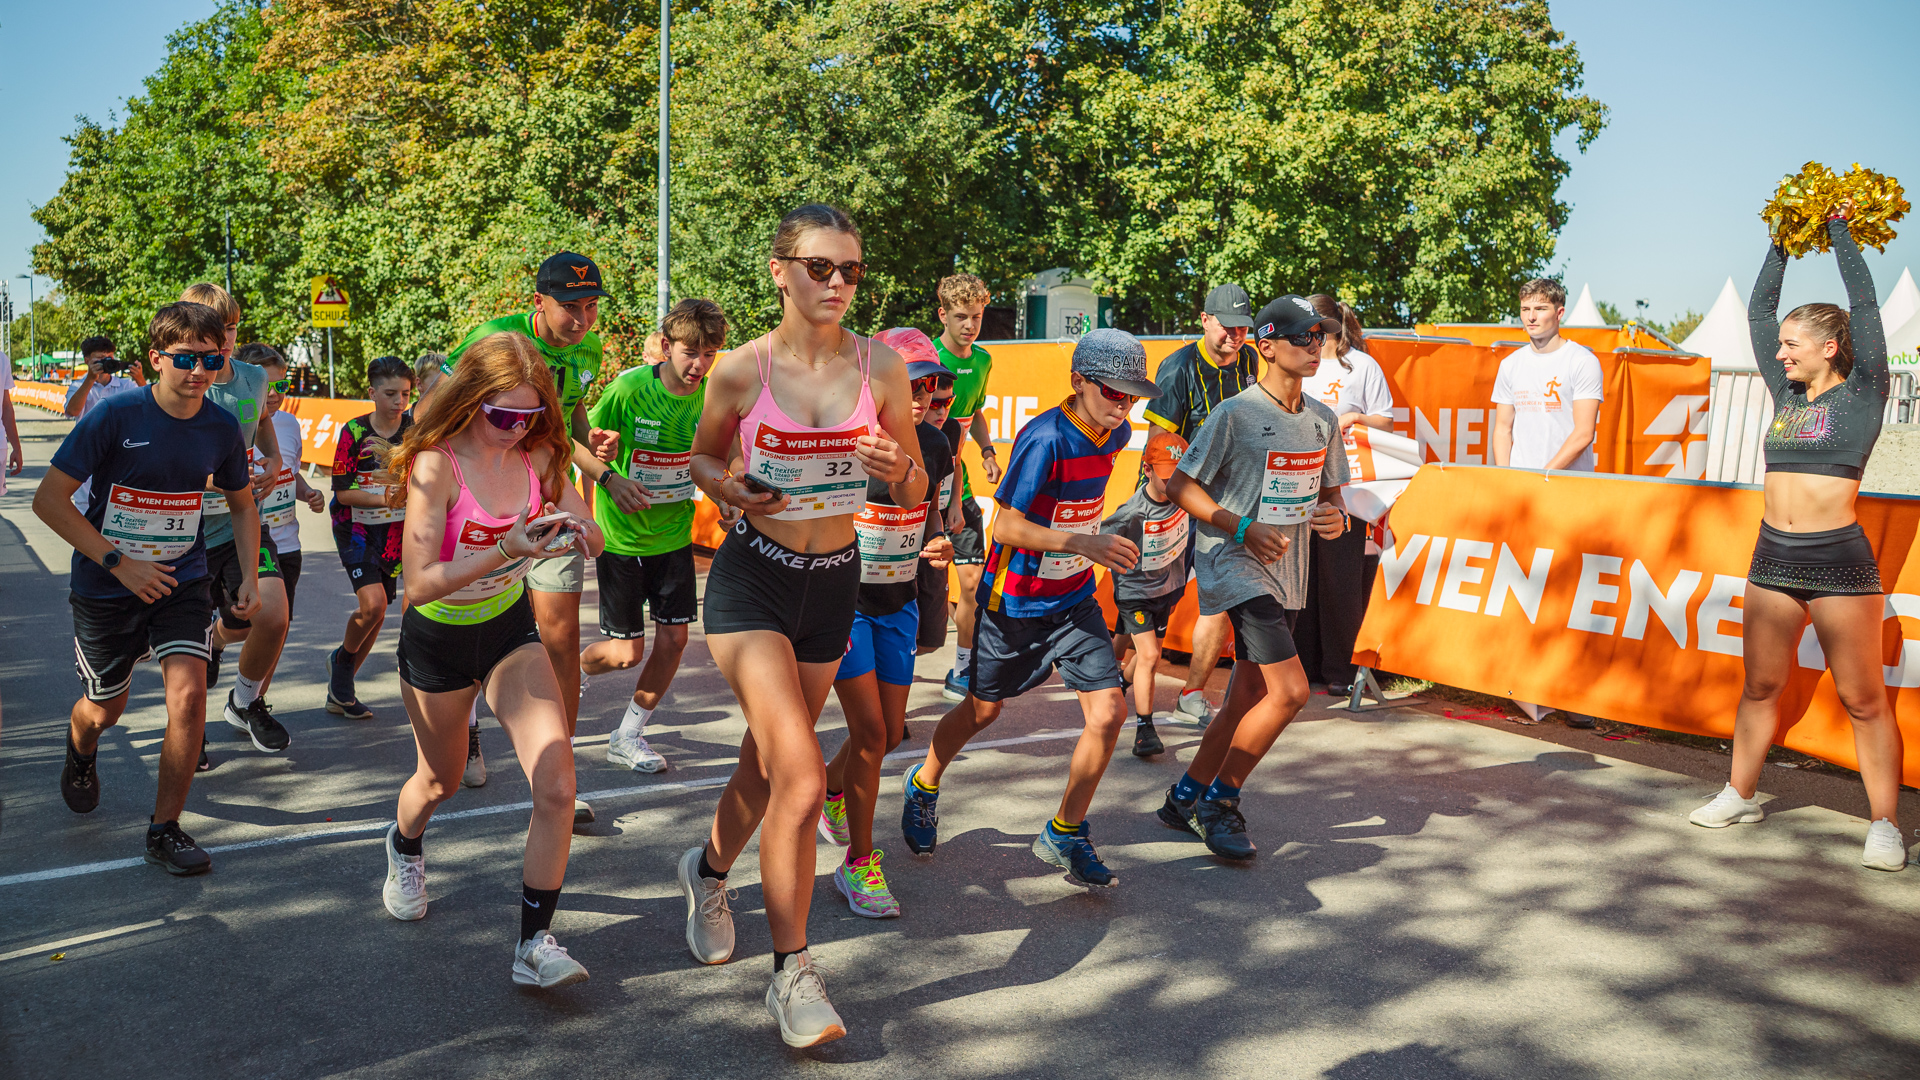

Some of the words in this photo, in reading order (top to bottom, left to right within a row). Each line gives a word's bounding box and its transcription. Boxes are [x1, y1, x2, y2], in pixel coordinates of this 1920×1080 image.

[313, 310, 348, 321] SCHULE
[1065, 312, 1083, 326] TOI
[1887, 351, 1920, 365] ntu
[635, 416, 661, 427] Kempa
[785, 439, 817, 449] WIEN
[819, 438, 857, 447] ENERG
[673, 455, 690, 463] ENER
[759, 450, 796, 461] BUSINESS
[1290, 458, 1308, 466] WIEN
[824, 461, 853, 477] 32
[675, 469, 690, 481] 53
[1309, 475, 1320, 490] 27
[276, 489, 289, 501] 24
[137, 496, 162, 505] WIEN
[163, 498, 198, 507] ENERGIE
[114, 504, 144, 514] BUSINESS
[1077, 509, 1093, 517] WIEN
[878, 512, 901, 521] WIEN
[901, 509, 925, 520] ENERGIE
[164, 518, 185, 531] 31
[854, 521, 883, 531] BUSINESS
[1176, 522, 1185, 537] 10
[493, 532, 506, 540] WI
[900, 532, 916, 549] 26
[749, 535, 810, 569] NIKE
[808, 549, 855, 571] PRO
[352, 567, 363, 579] CB
[436, 602, 495, 625] NIKE
[671, 616, 690, 624] Kempa
[610, 630, 626, 639] Kempa
